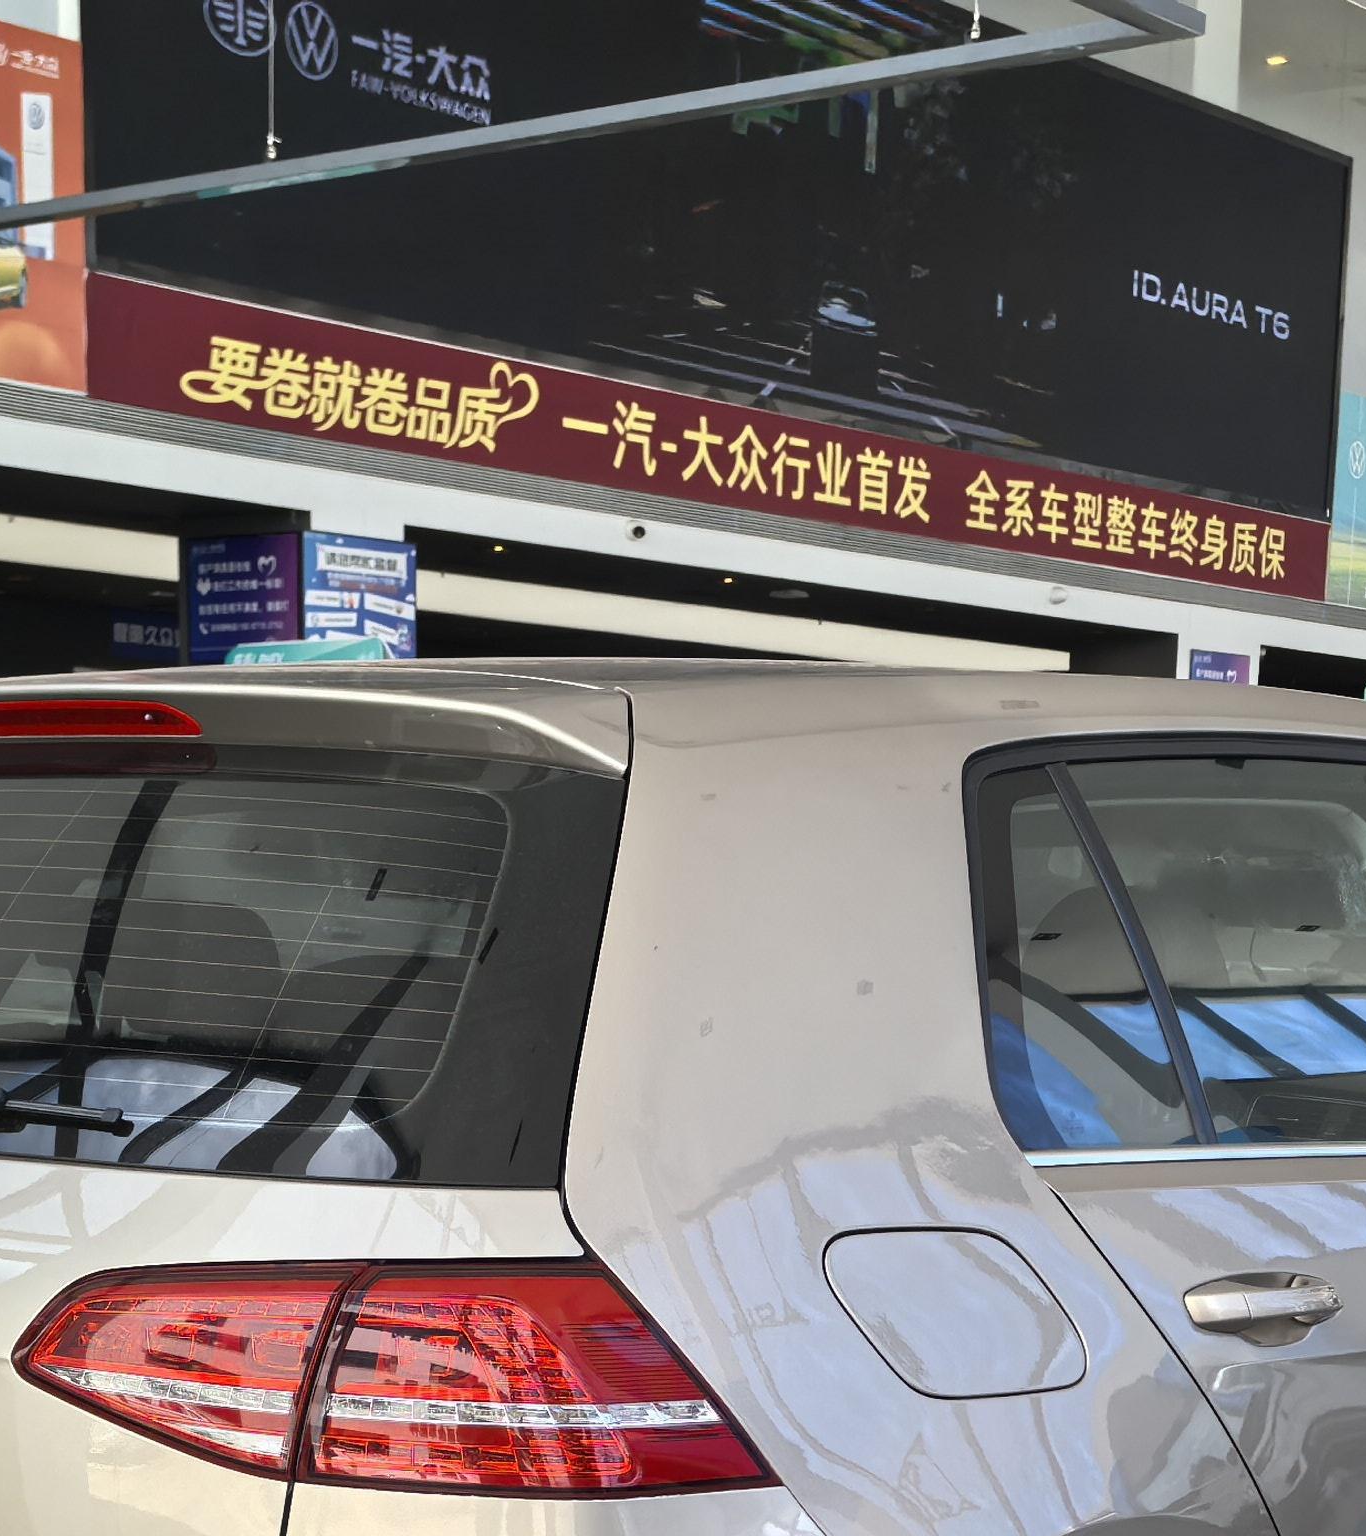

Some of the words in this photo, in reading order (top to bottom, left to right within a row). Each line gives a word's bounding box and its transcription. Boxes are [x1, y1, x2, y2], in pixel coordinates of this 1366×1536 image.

[350, 69, 492, 127] FAW-VOLKSWAGEN
[1254, 305, 1291, 341] T6
[180, 335, 539, 453] 要卷就卷品质
[561, 400, 932, 524] 一汽-大众行业首发
[965, 469, 1287, 581] 全系车型整车终身质保
